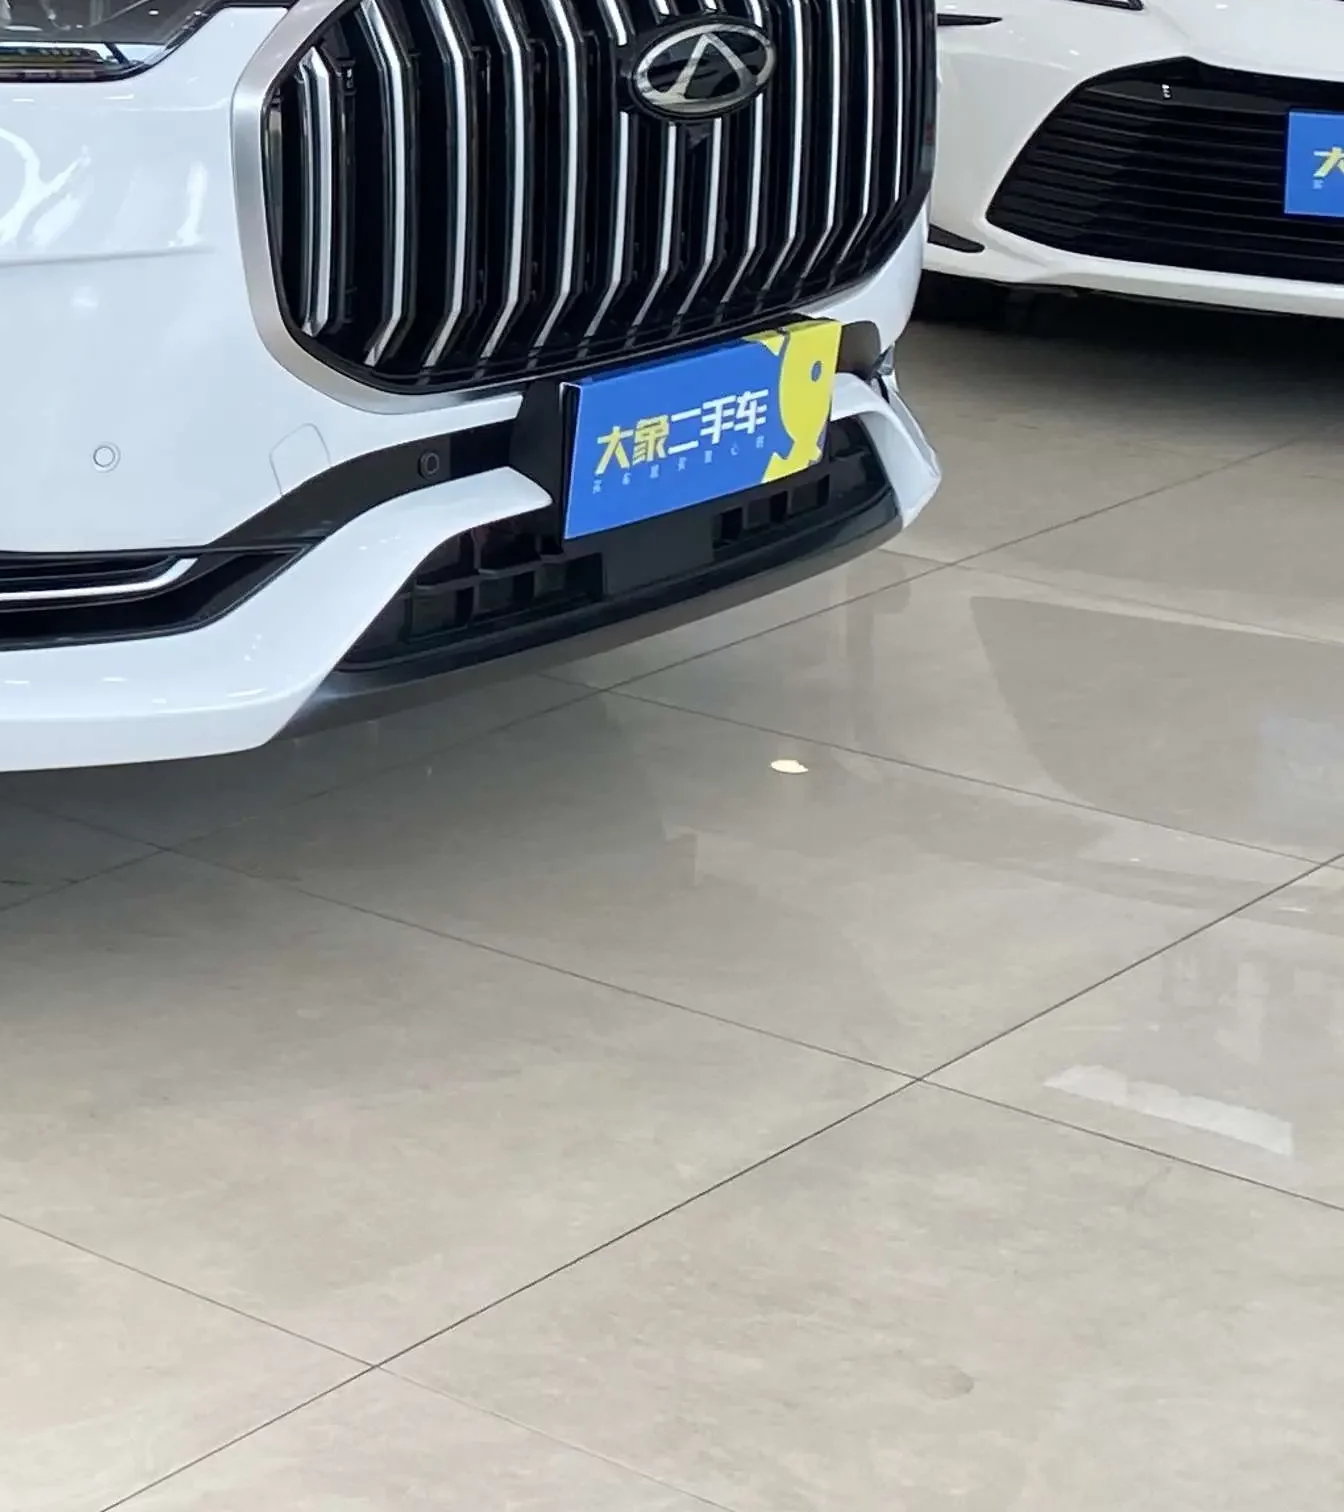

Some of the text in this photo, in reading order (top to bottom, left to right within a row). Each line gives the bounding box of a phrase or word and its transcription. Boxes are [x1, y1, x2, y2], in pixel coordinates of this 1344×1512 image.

[593, 389, 769, 477] 大象二手车
